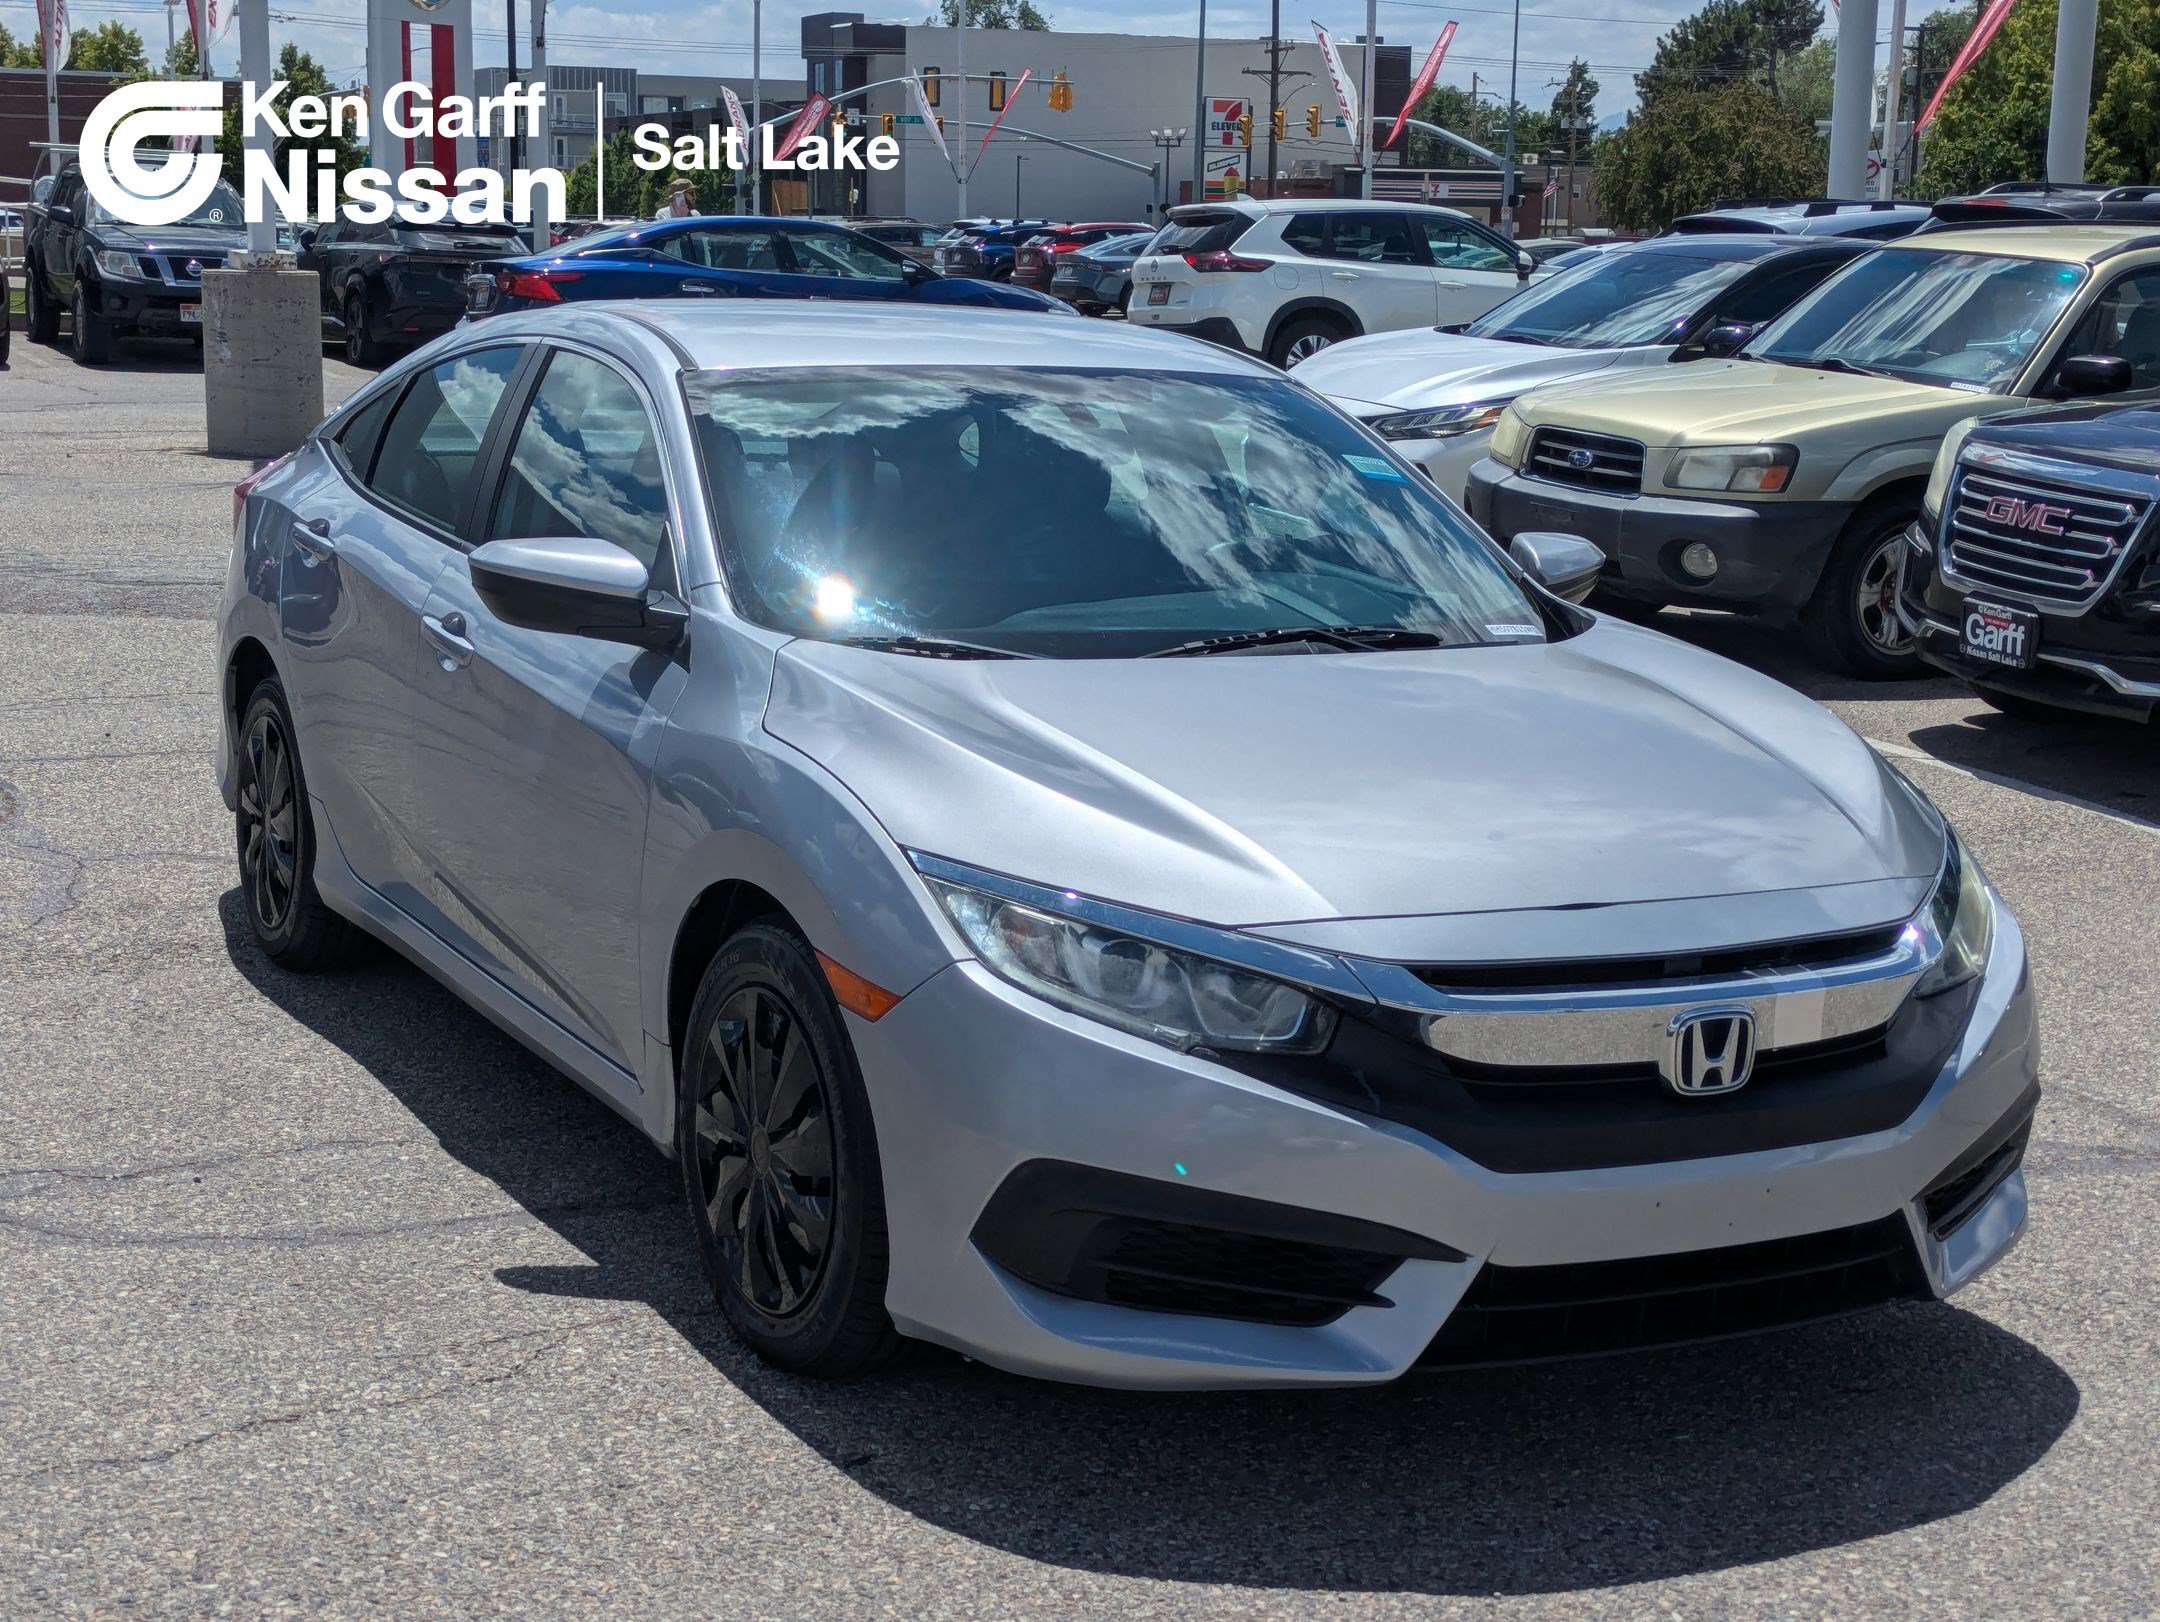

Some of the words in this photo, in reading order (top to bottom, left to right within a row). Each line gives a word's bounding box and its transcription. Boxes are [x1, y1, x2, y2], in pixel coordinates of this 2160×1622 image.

[1985, 496, 2070, 536] GMC
[1966, 613, 2025, 656] Garff
[1967, 645, 1987, 659] Nissan
[1988, 651, 2001, 662] Salt
[2001, 654, 2017, 667] Lake
